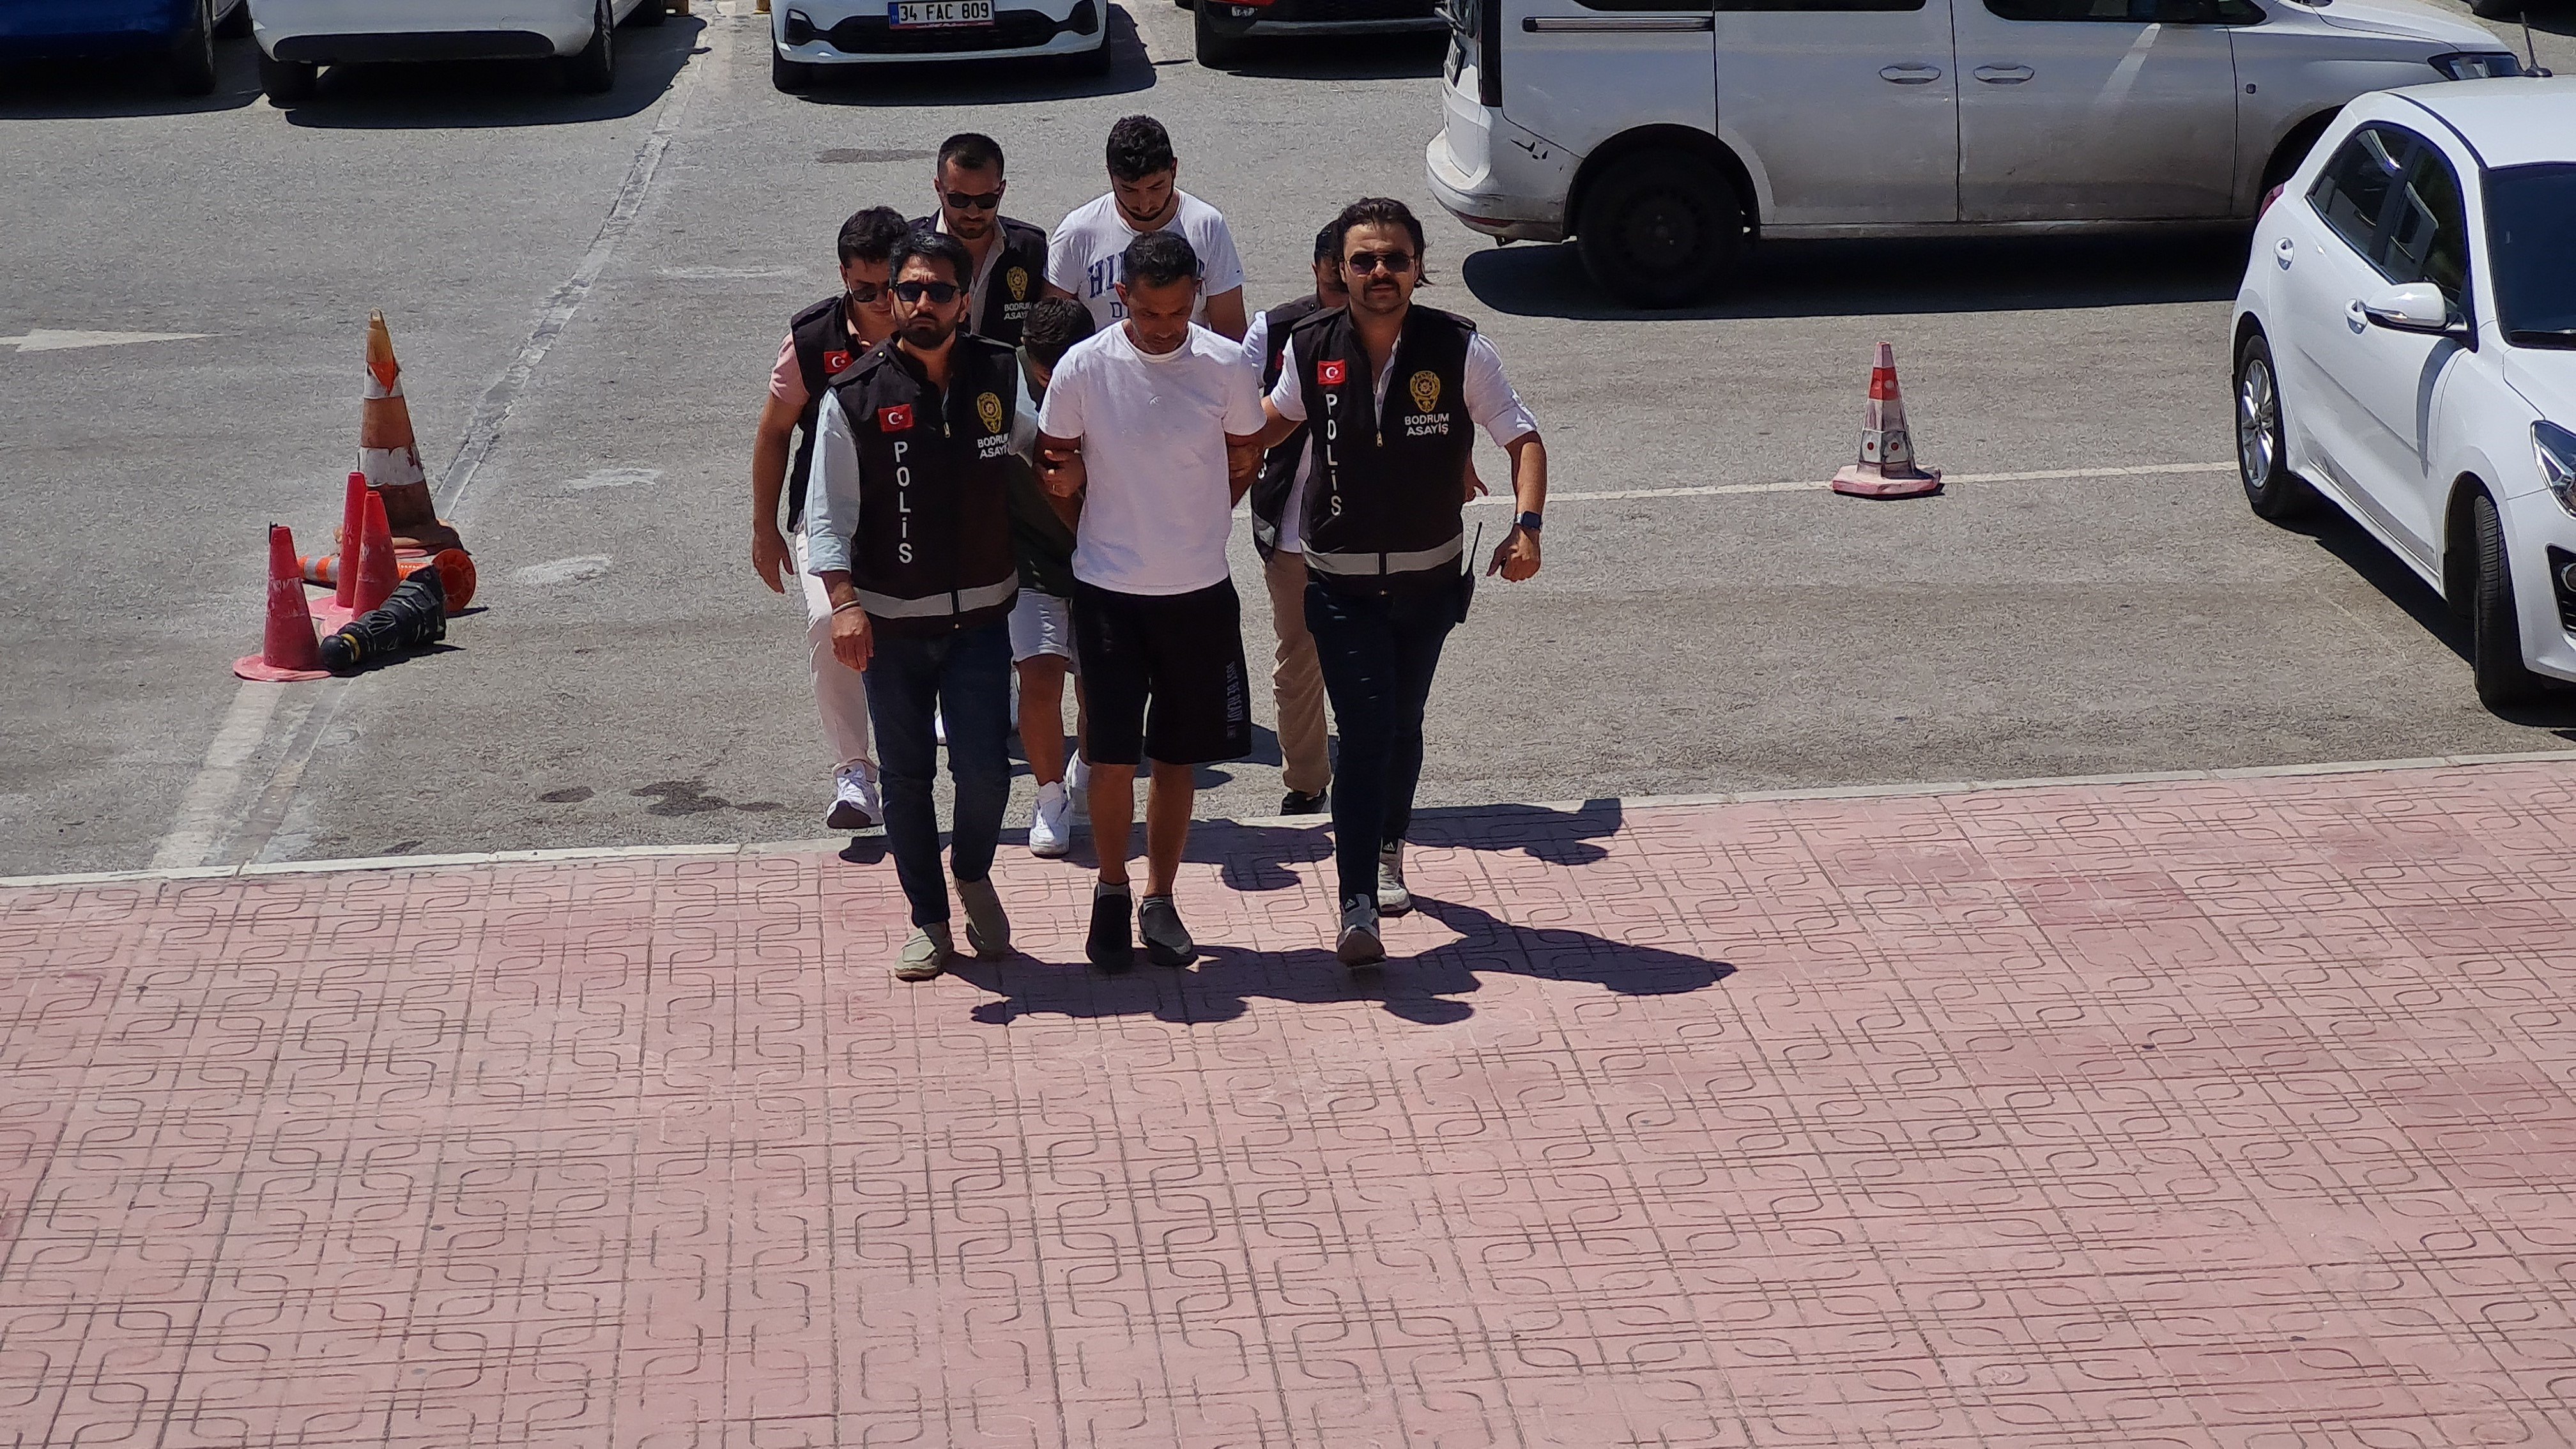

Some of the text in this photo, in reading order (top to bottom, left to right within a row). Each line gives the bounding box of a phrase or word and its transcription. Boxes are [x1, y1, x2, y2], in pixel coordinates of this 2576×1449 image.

[900, 3, 989, 21] 34 FAC 809
[1404, 413, 1449, 425] BODRUM
